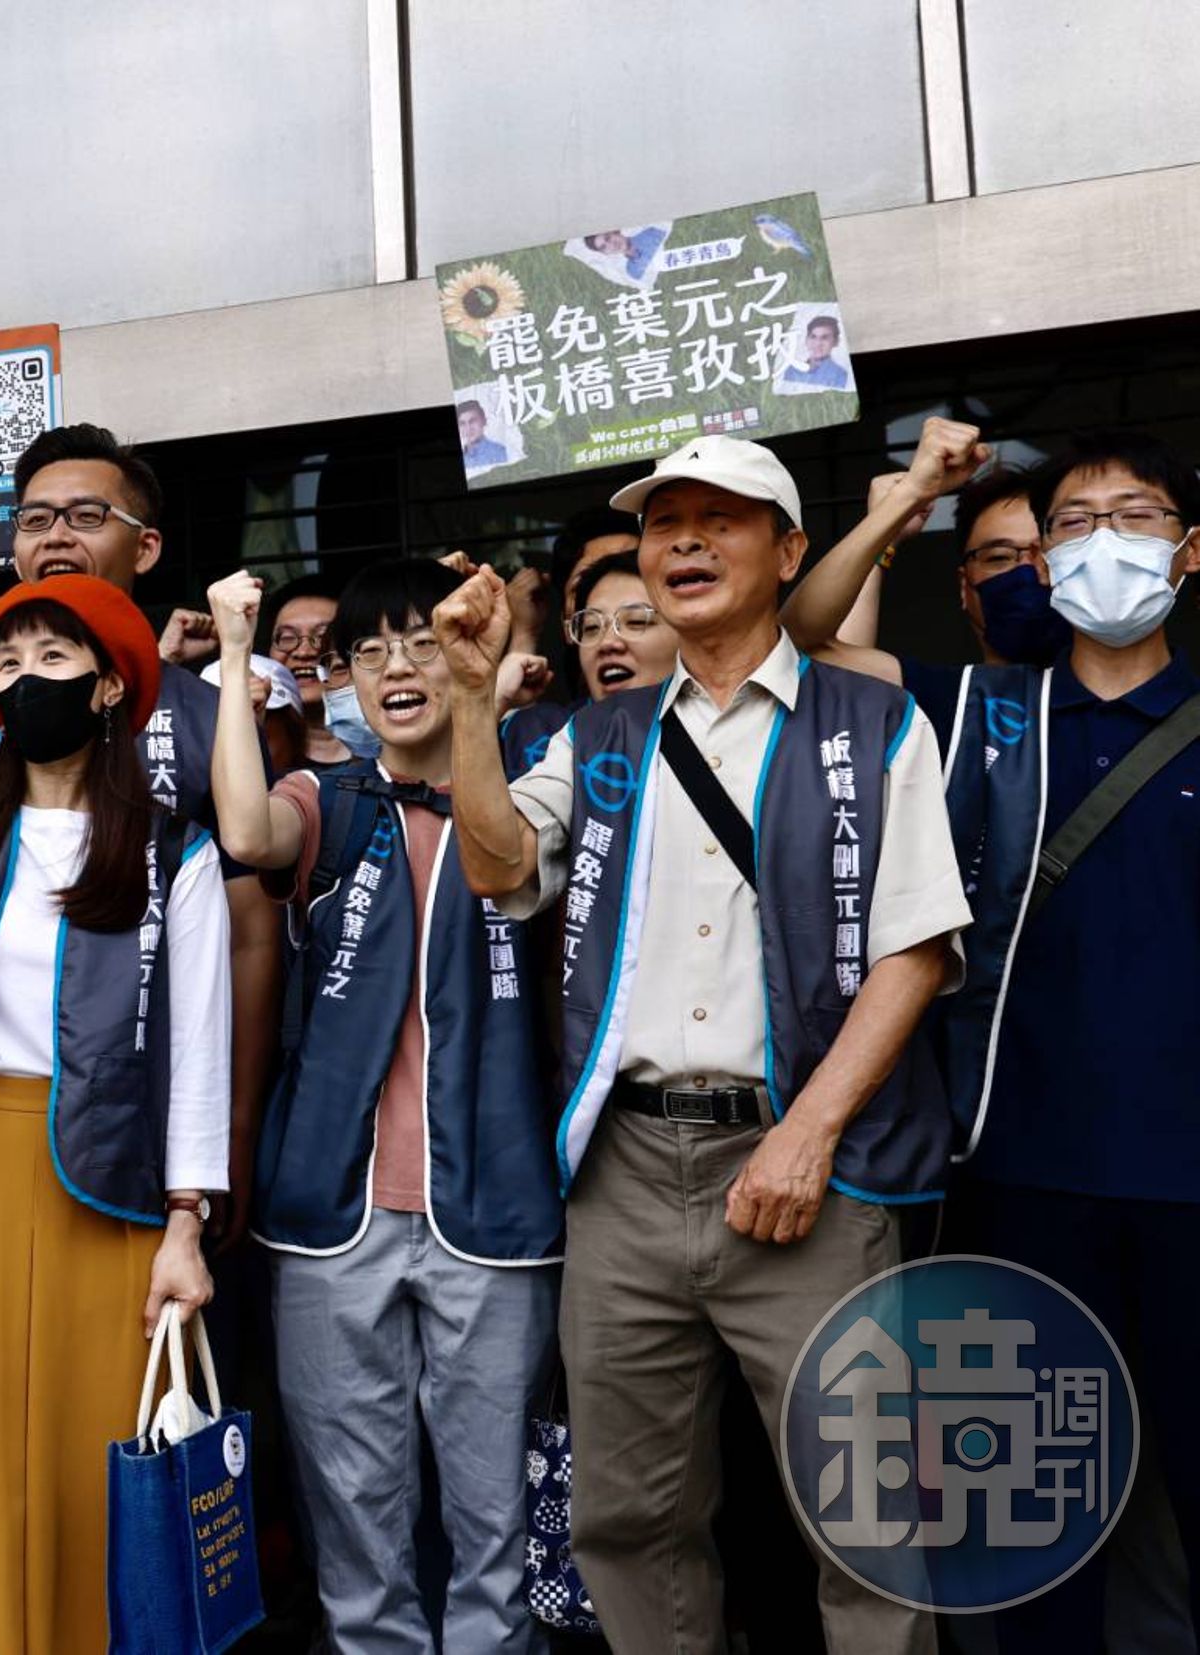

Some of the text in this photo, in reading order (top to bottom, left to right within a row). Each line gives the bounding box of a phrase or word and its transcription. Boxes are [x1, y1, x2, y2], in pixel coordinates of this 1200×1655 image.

[664, 242, 733, 268] 春季青鳥
[485, 266, 798, 371] 罷免葉元之
[494, 321, 810, 425] 板橋喜孜孜
[819, 730, 862, 998] 板橋大刪元團隊
